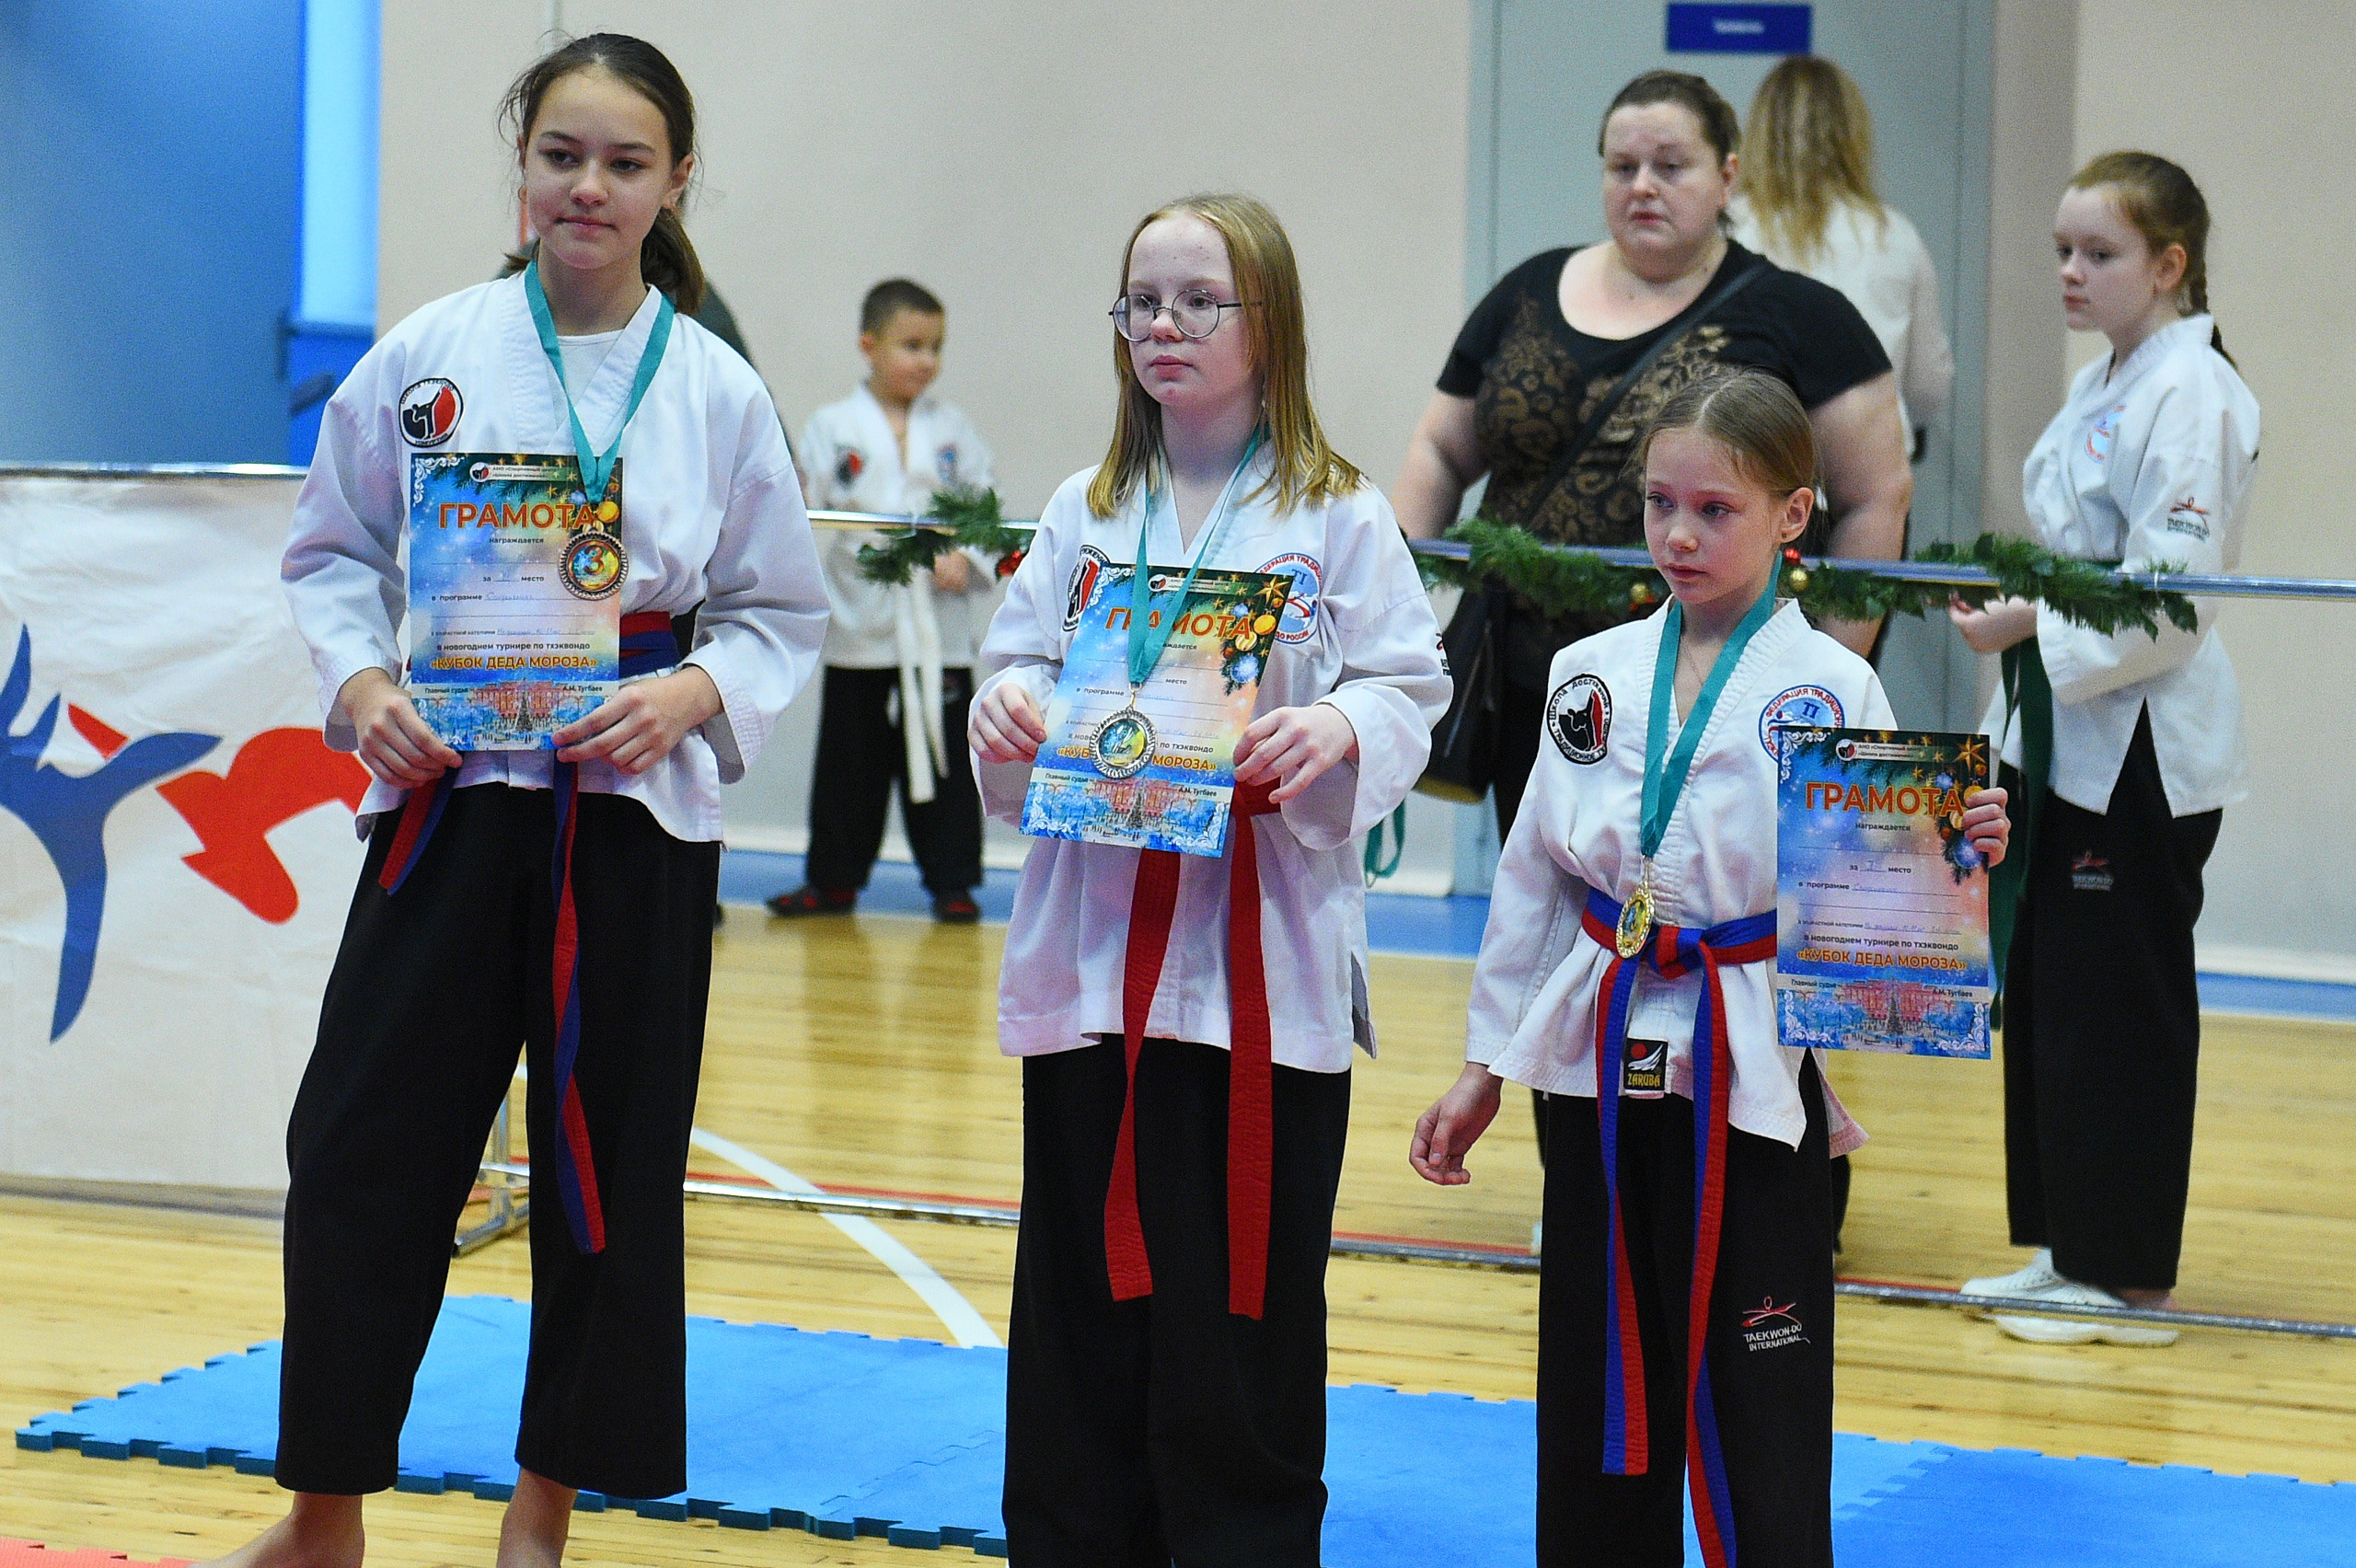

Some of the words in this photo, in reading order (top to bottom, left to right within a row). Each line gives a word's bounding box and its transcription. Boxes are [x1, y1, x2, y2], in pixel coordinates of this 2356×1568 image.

[439, 503, 595, 529] ГРАМОТА
[583, 545, 605, 576] 3
[431, 656, 483, 670] «КУБОК
[486, 656, 526, 670] ДЕДА
[529, 655, 598, 669] МОРОЗА»
[1083, 687, 1125, 697] программе
[1549, 688, 1568, 721] Школа
[1057, 745, 1091, 758] «КУБ
[1172, 744, 1214, 753] тхэквондо
[1152, 755, 1218, 771] МОРОЗА»
[1806, 782, 1965, 817] ГРАМОТА
[1855, 823, 1911, 832] награждается
[1807, 882, 1850, 890] программе
[1811, 935, 1861, 945] новогоднем
[1864, 939, 1899, 949] турнире
[1914, 941, 1959, 951] тхэквондо
[1797, 949, 1851, 963] «КУБОК
[1854, 952, 1894, 966] ДЕДА
[1898, 955, 1967, 970] МОРОЗА»
[1791, 979, 1817, 987] Главный
[1627, 1073, 1661, 1088] ZARUBA
[1743, 1324, 1802, 1343] TAEKWON-DO
[1749, 1333, 1804, 1352] INTERNATIONAL
